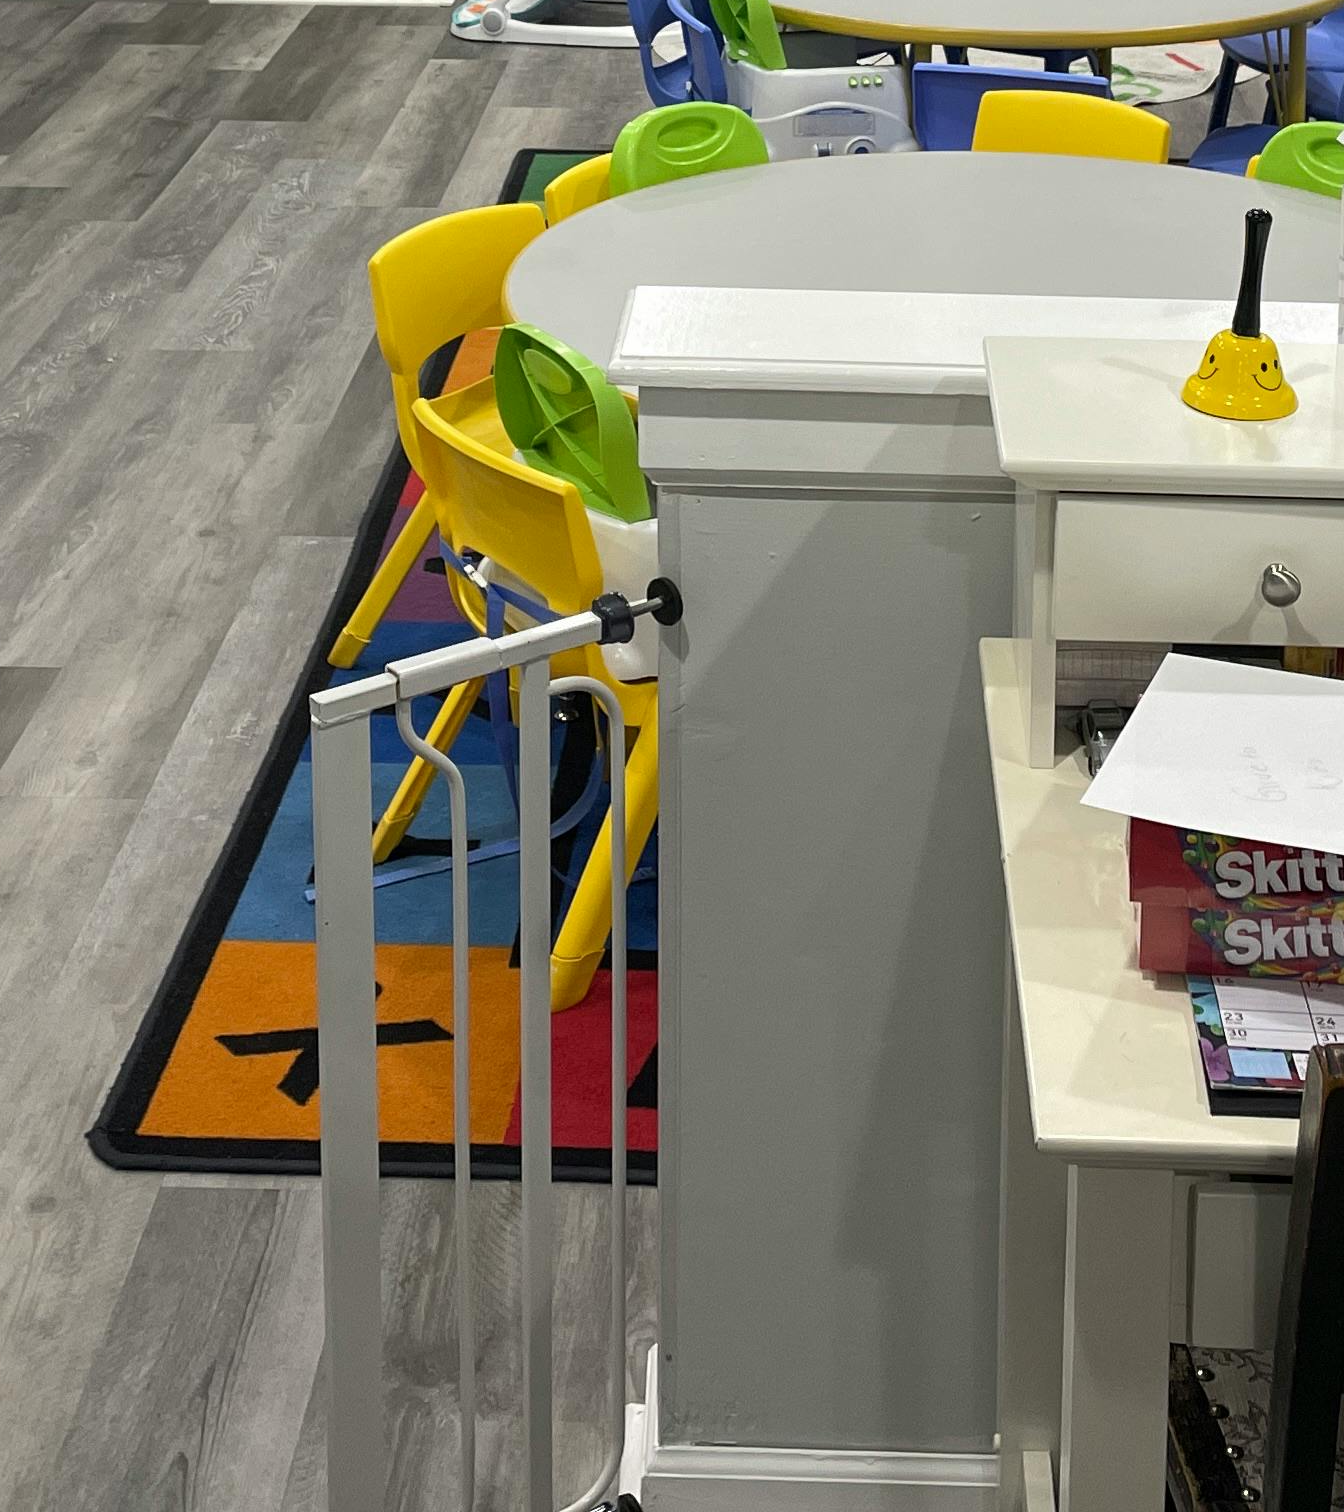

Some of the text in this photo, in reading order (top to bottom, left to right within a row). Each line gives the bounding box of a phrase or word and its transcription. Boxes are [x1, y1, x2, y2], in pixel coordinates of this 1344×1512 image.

[1223, 1012, 1244, 1022] 23
[1315, 1017, 1337, 1026] 24
[1228, 1029, 1338, 1042] 30 31
